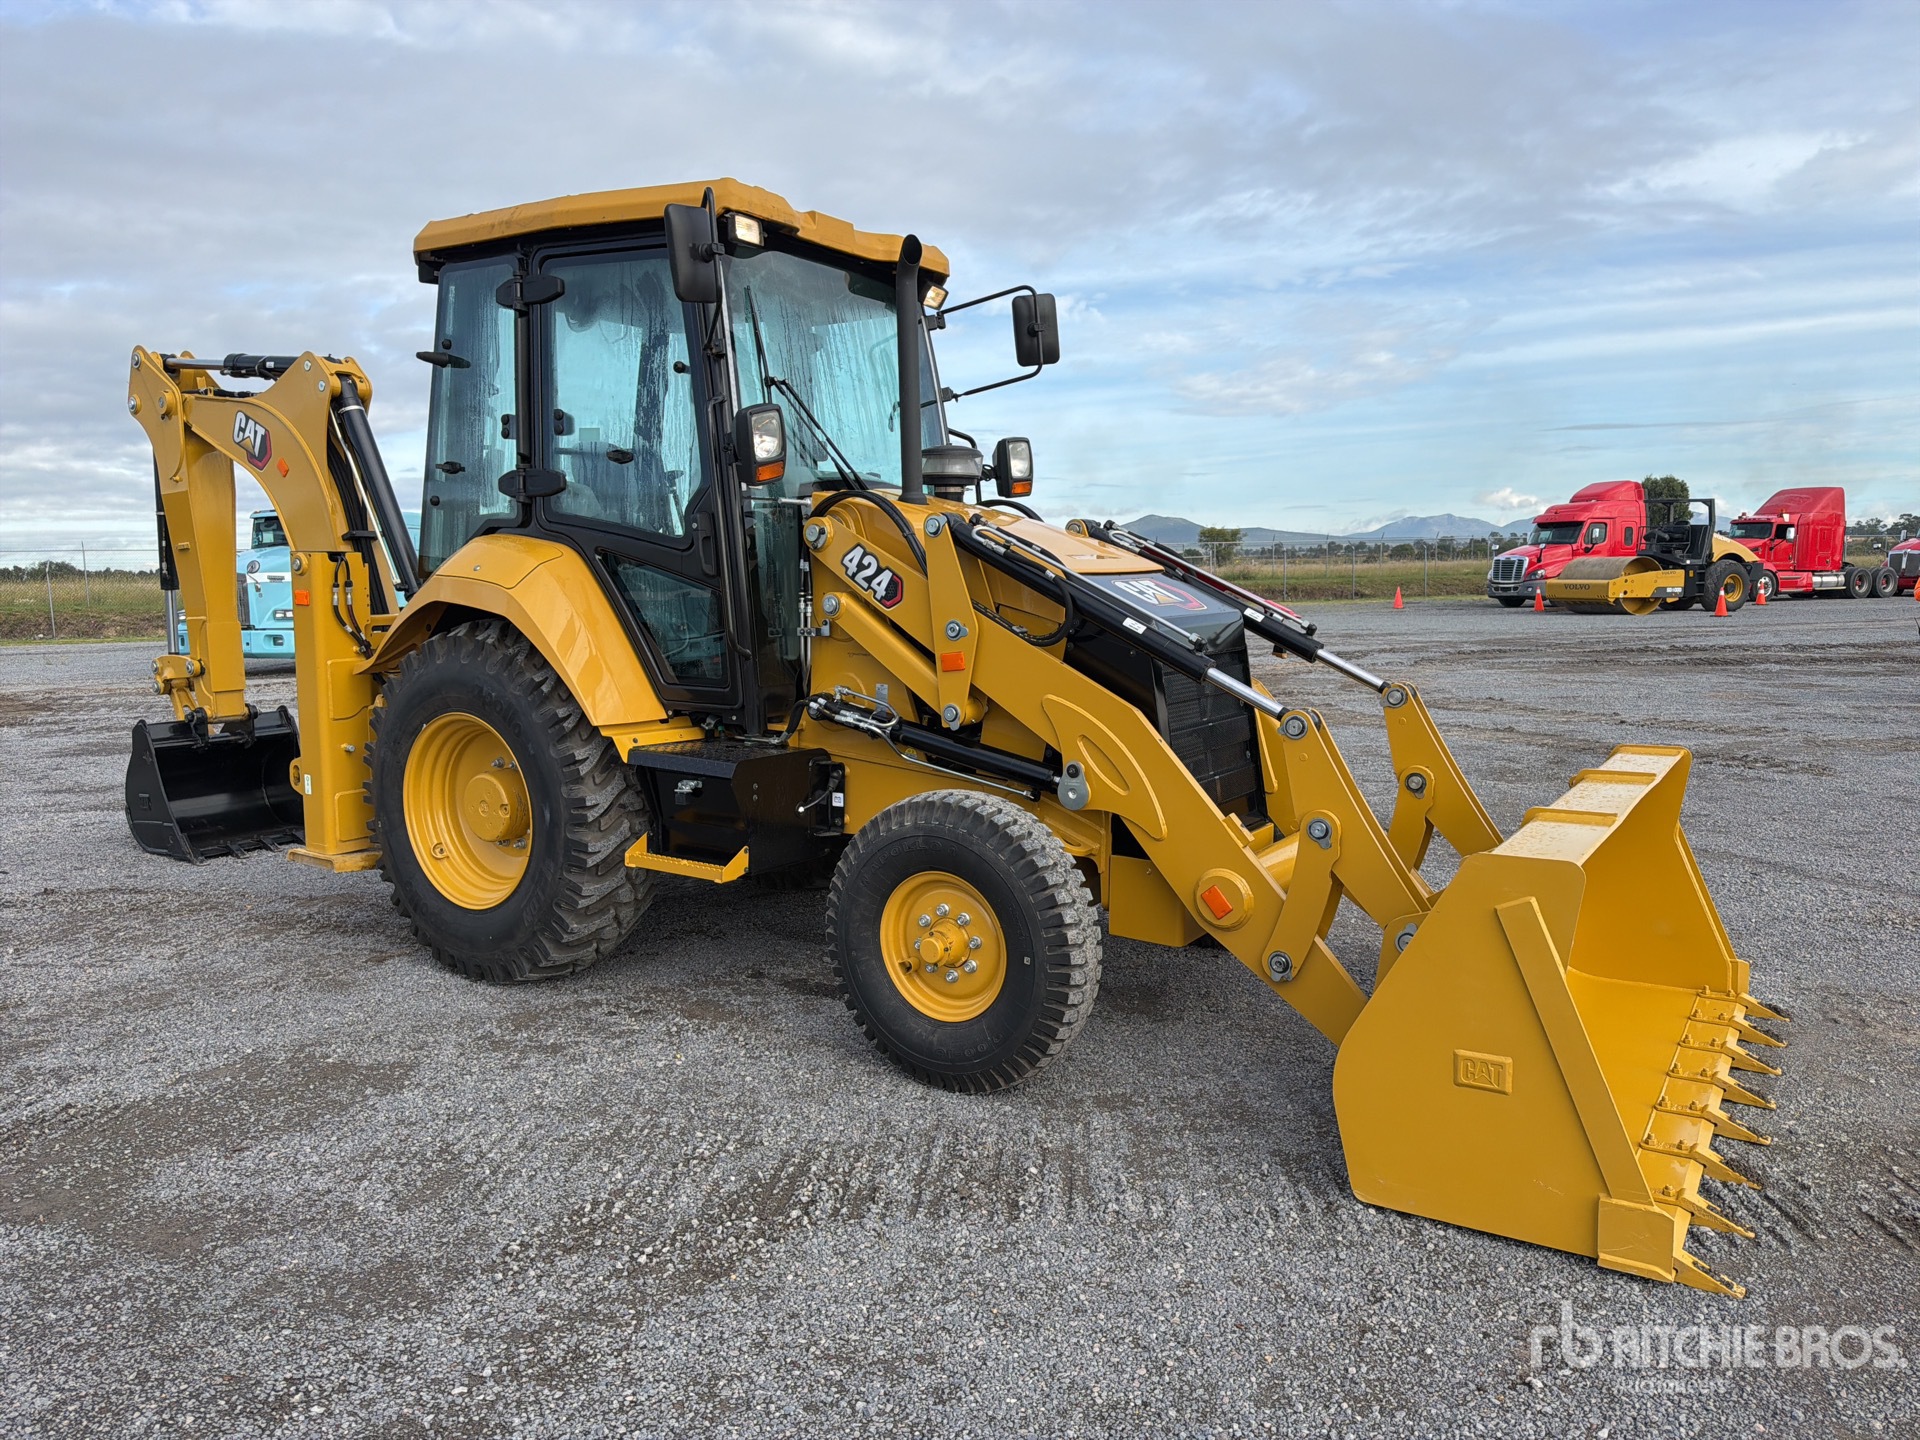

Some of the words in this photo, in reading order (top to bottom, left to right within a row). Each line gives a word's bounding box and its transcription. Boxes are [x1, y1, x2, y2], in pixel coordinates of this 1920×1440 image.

[233, 411, 266, 457] CAT
[842, 545, 893, 601] 424
[1564, 583, 1591, 591] VOLVO
[1113, 580, 1185, 605] CAT
[1461, 1058, 1503, 1089] CAT
